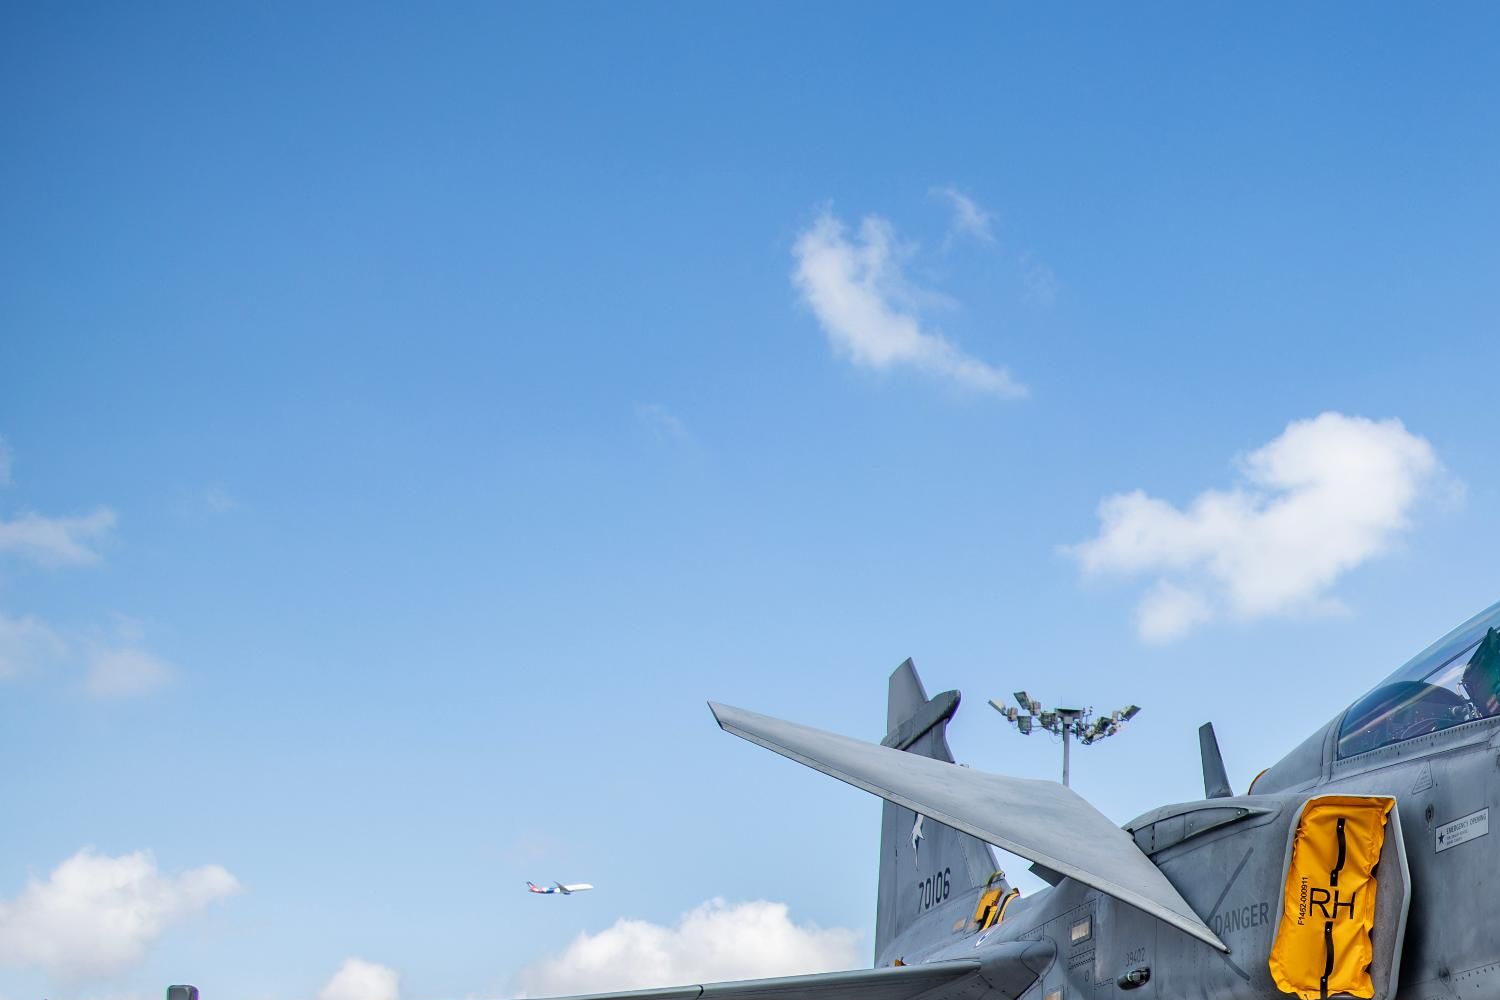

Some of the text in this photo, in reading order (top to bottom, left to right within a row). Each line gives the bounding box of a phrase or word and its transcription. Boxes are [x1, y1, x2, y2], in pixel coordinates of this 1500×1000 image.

[918, 866, 951, 915] 70106
[1309, 887, 1356, 919] RH
[1215, 902, 1269, 936] DANGER
